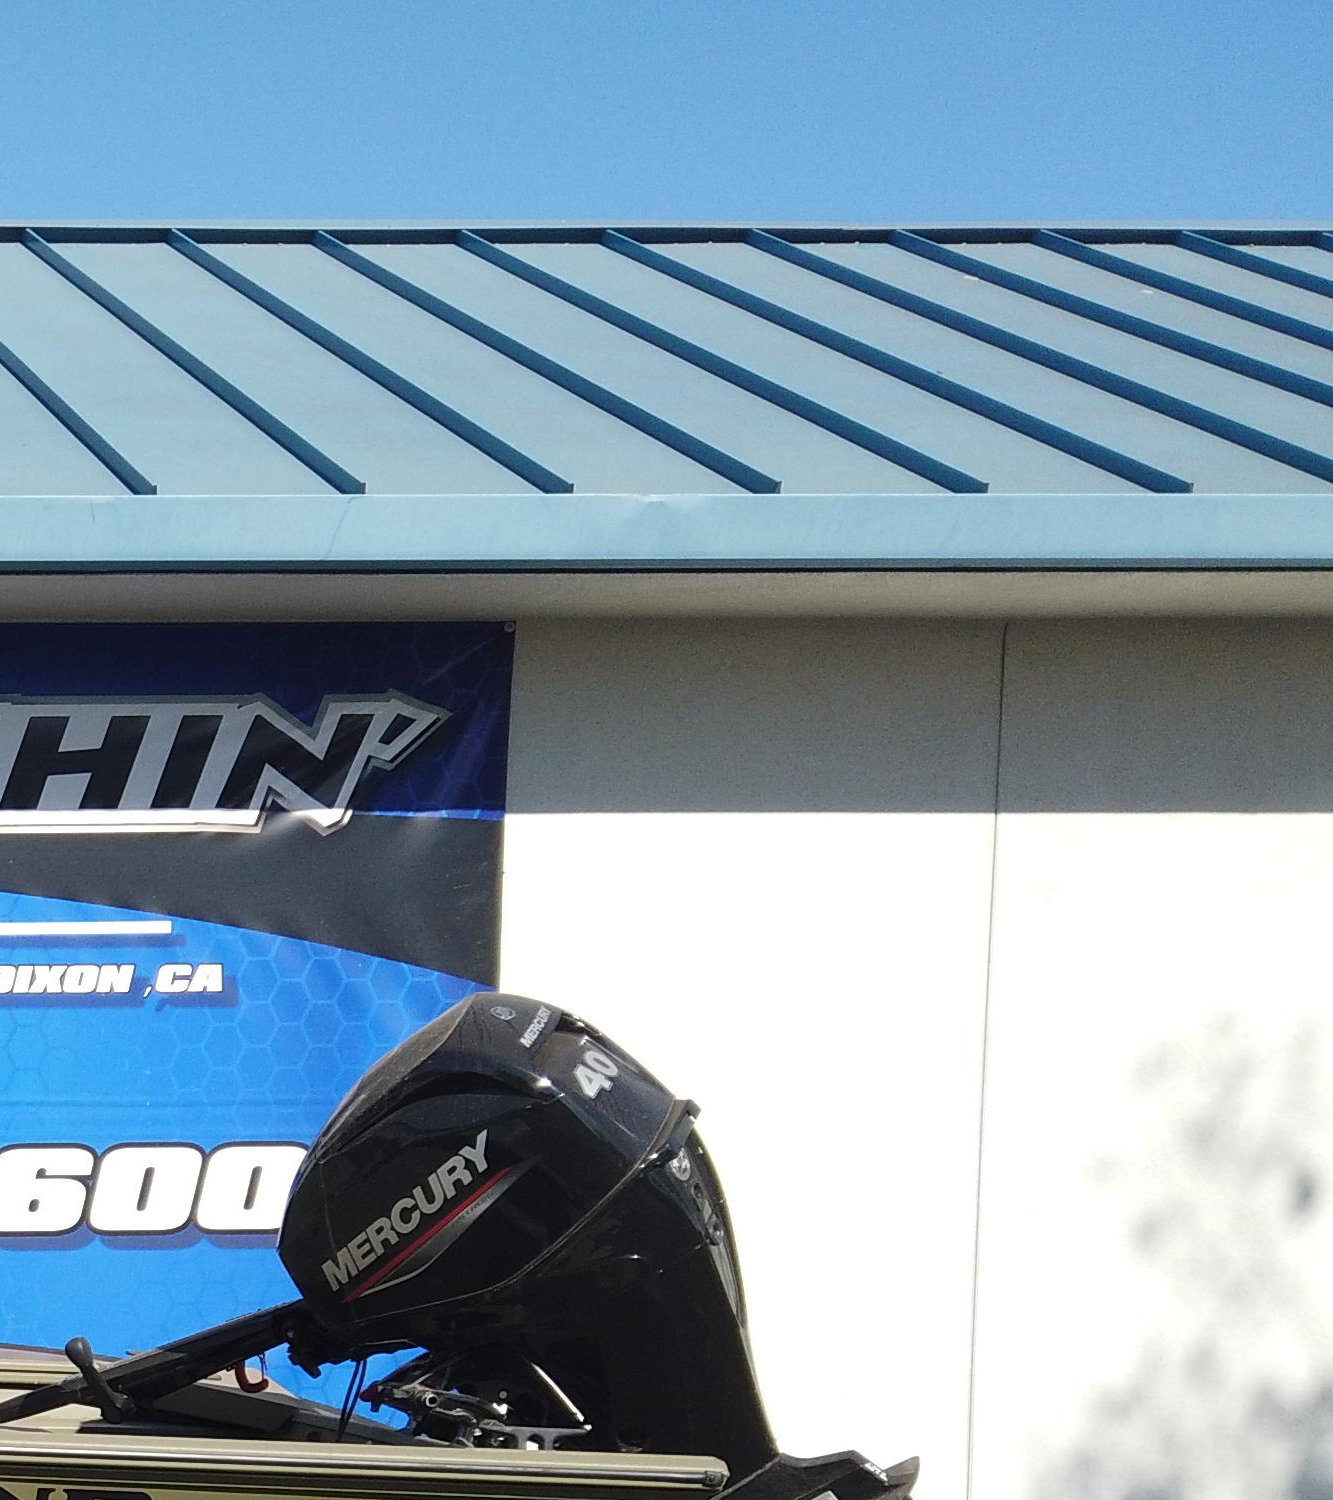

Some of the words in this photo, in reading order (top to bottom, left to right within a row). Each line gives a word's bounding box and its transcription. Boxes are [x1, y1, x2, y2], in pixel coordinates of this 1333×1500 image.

[519, 1005, 552, 1049] MERCURY
[573, 1050, 620, 1099] 40
[321, 1129, 490, 1292] MERCURY
